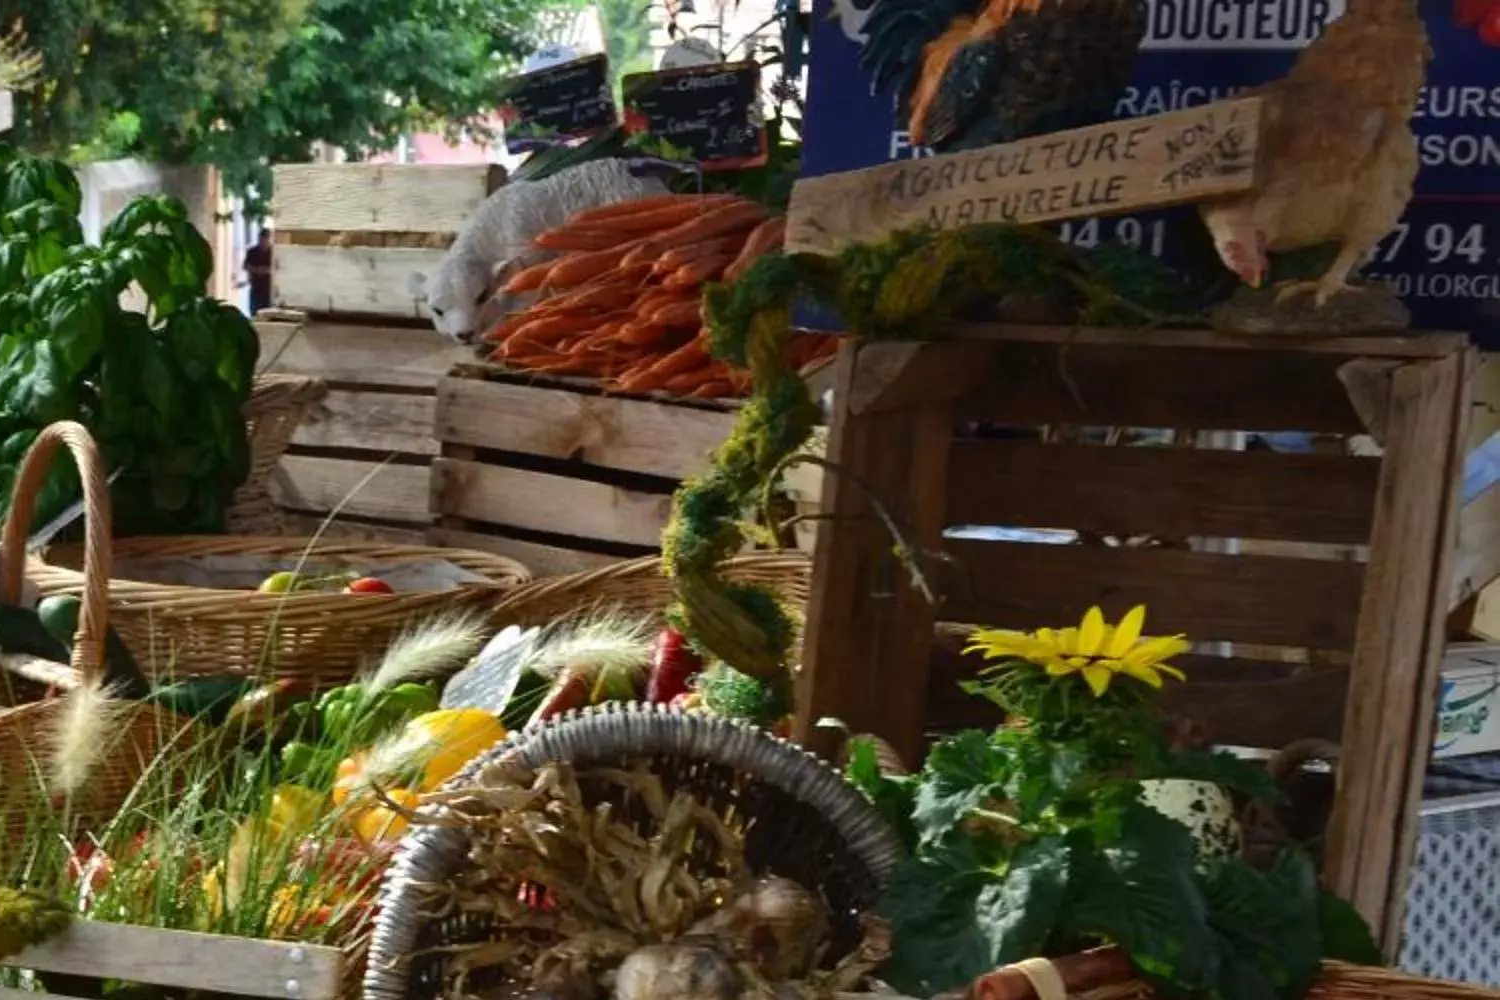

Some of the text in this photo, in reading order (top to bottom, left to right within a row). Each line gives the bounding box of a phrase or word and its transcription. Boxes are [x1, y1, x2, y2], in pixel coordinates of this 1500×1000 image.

[1151, 0, 1330, 40] DUCTEUR
[886, 125, 1153, 202] AGRICULTURE
[929, 173, 1128, 231] NATURELLE
[1424, 222, 1488, 265] 94
